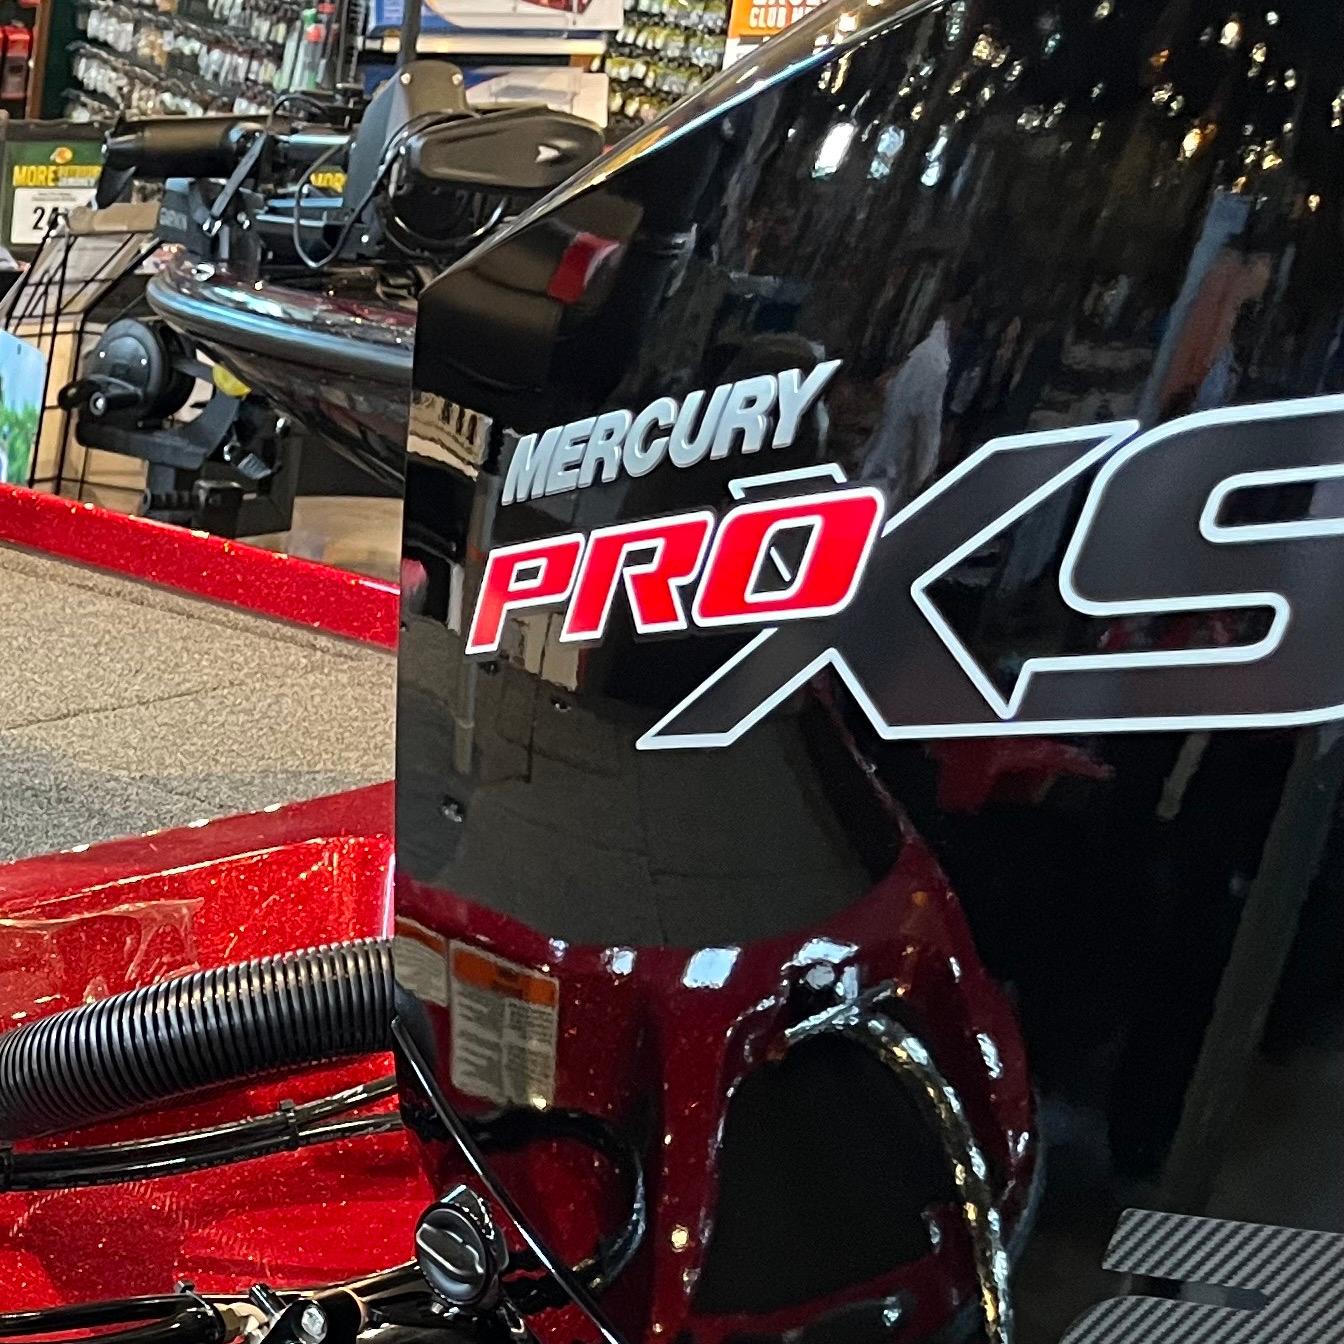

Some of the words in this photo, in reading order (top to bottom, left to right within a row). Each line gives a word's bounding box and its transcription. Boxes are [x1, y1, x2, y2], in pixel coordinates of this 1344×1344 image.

[750, 6, 787, 29] CLUB
[13, 165, 57, 187] MORE
[500, 358, 843, 507] MERCURY
[465, 485, 886, 656] PRO
[636, 393, 1344, 750] XS
